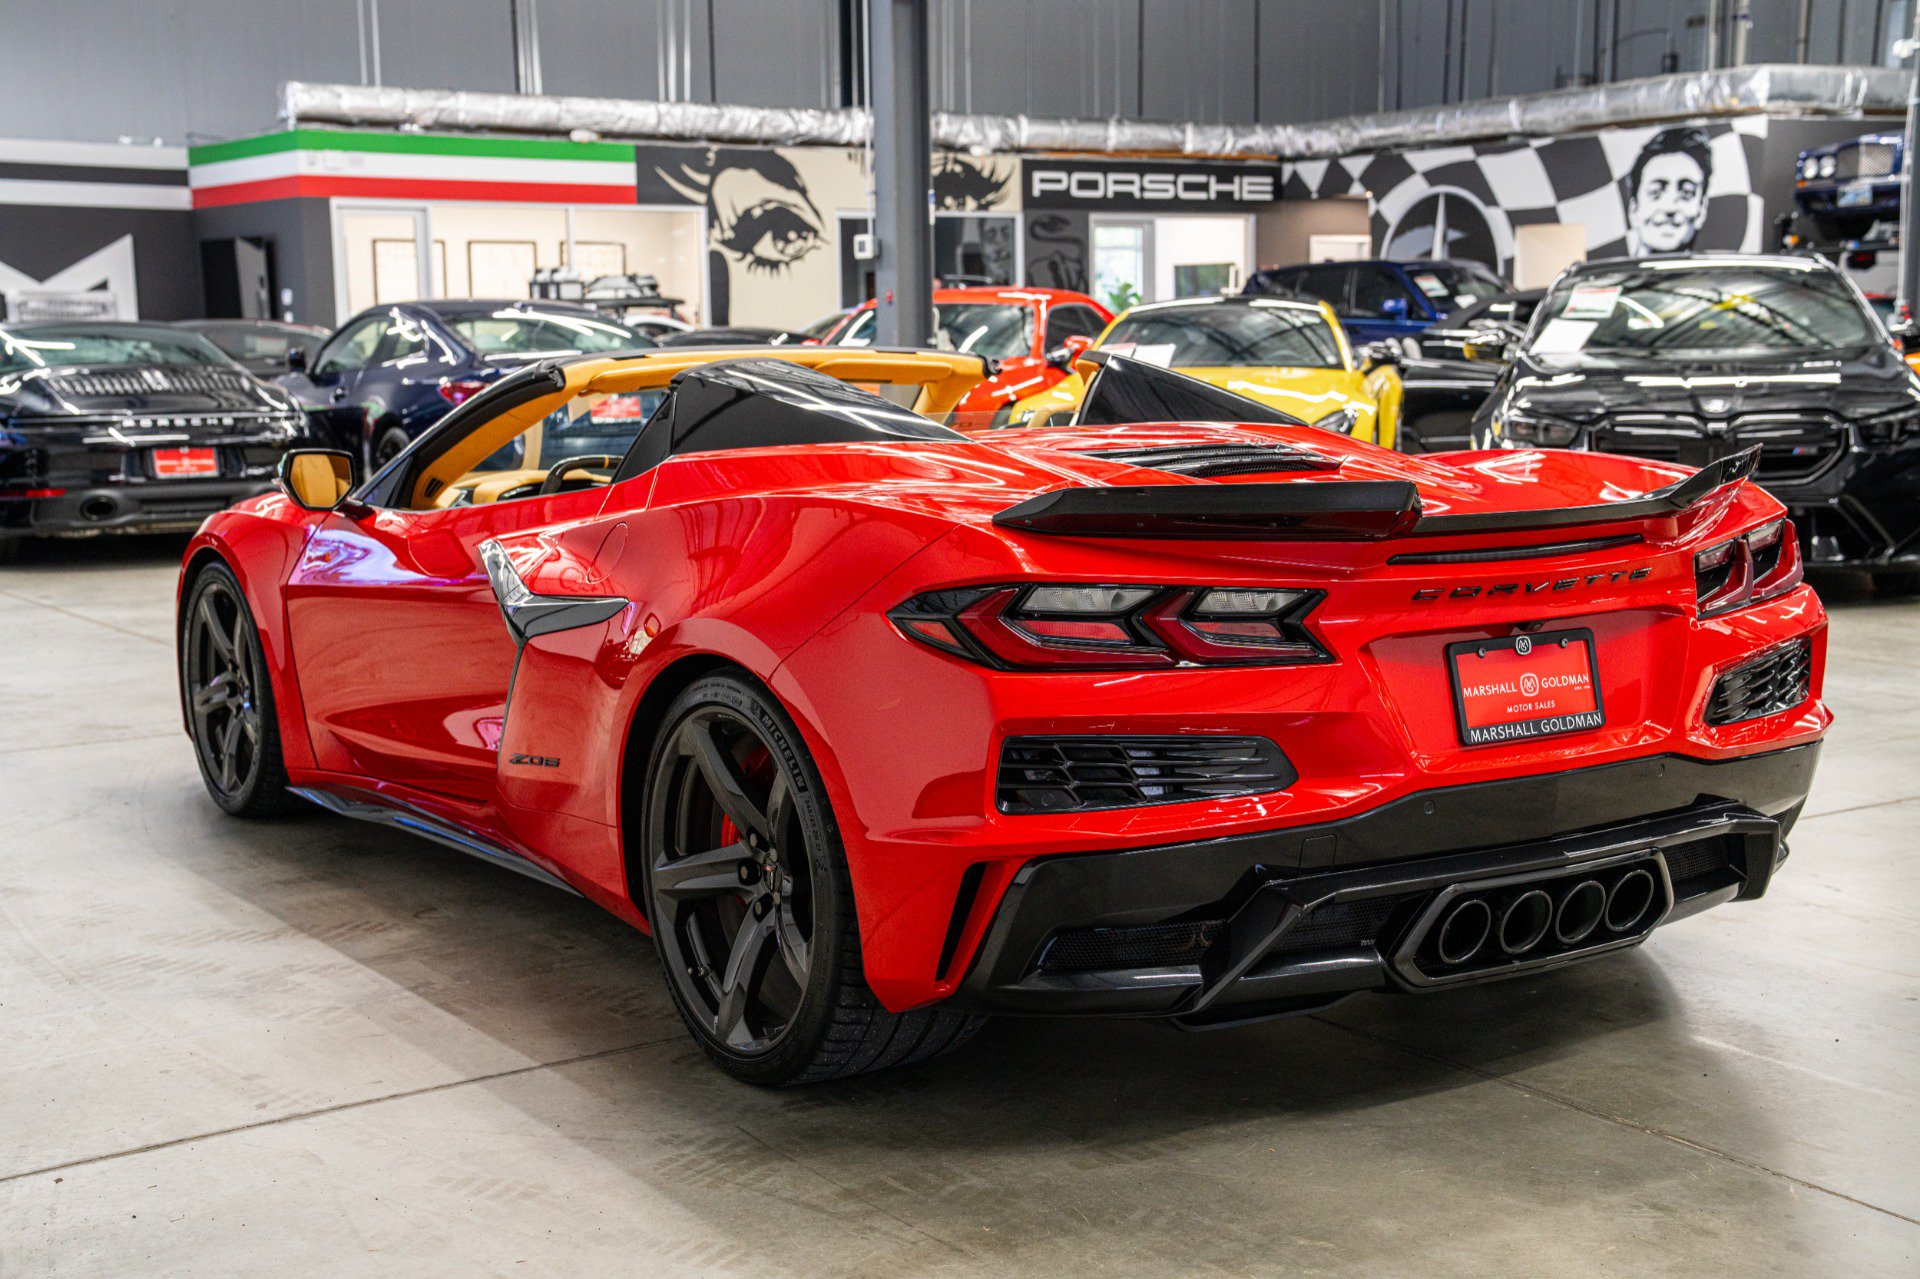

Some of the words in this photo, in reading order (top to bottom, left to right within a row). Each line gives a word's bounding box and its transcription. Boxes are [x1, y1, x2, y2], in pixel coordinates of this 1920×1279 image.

[1031, 170, 1274, 201] PORSCHE
[122, 417, 236, 428] PORSCHE
[1410, 566, 1653, 601] CORVETTE
[1462, 681, 1518, 698] MARSHALL
[1541, 673, 1590, 689] GOLDMAN
[1506, 703, 1533, 713] MOTOR
[1534, 700, 1556, 711] SALES
[1470, 722, 1538, 743] MARSHALL
[1540, 712, 1602, 733] GOLDMAN
[509, 753, 561, 768] Z06
[761, 714, 805, 788] MICHELIN
